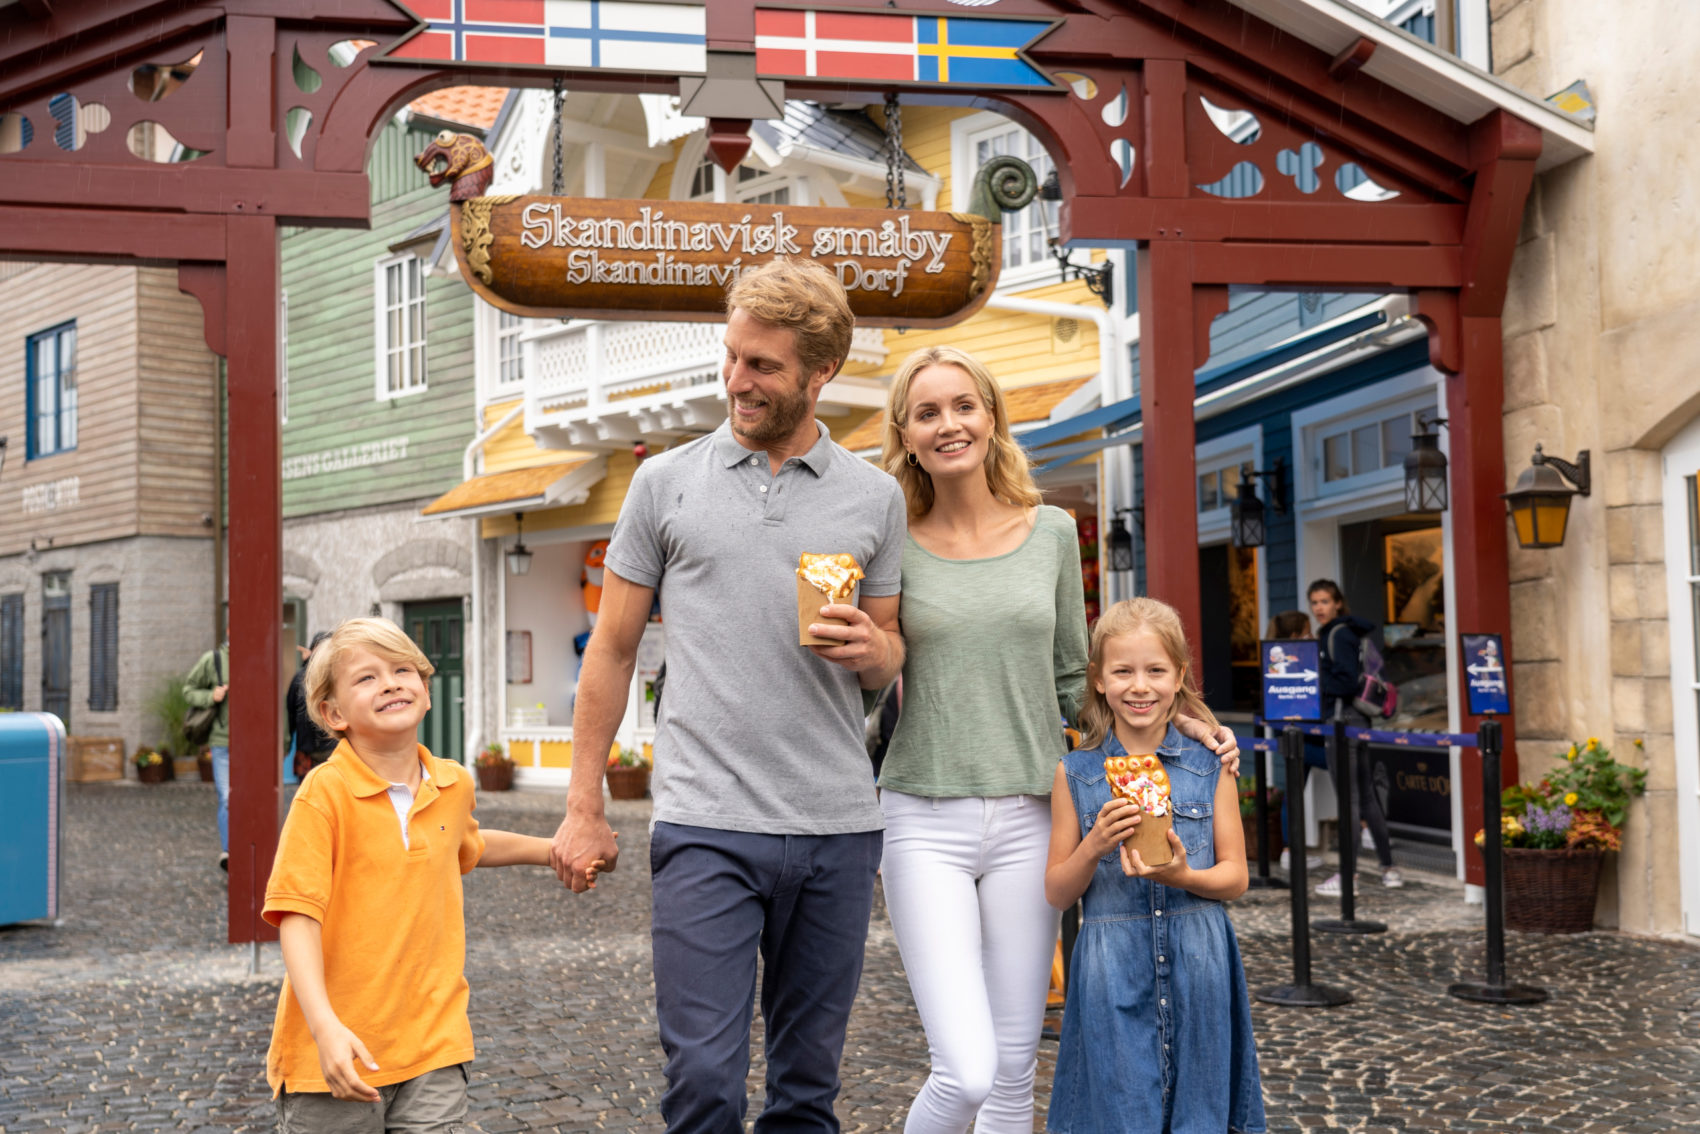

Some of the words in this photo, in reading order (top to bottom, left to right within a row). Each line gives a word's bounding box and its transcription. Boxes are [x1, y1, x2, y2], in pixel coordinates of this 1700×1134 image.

[521, 203, 802, 256] Skandinavisk
[811, 215, 953, 274] småby
[834, 258, 912, 298] Dorf
[1268, 684, 1317, 695] Ausgang
